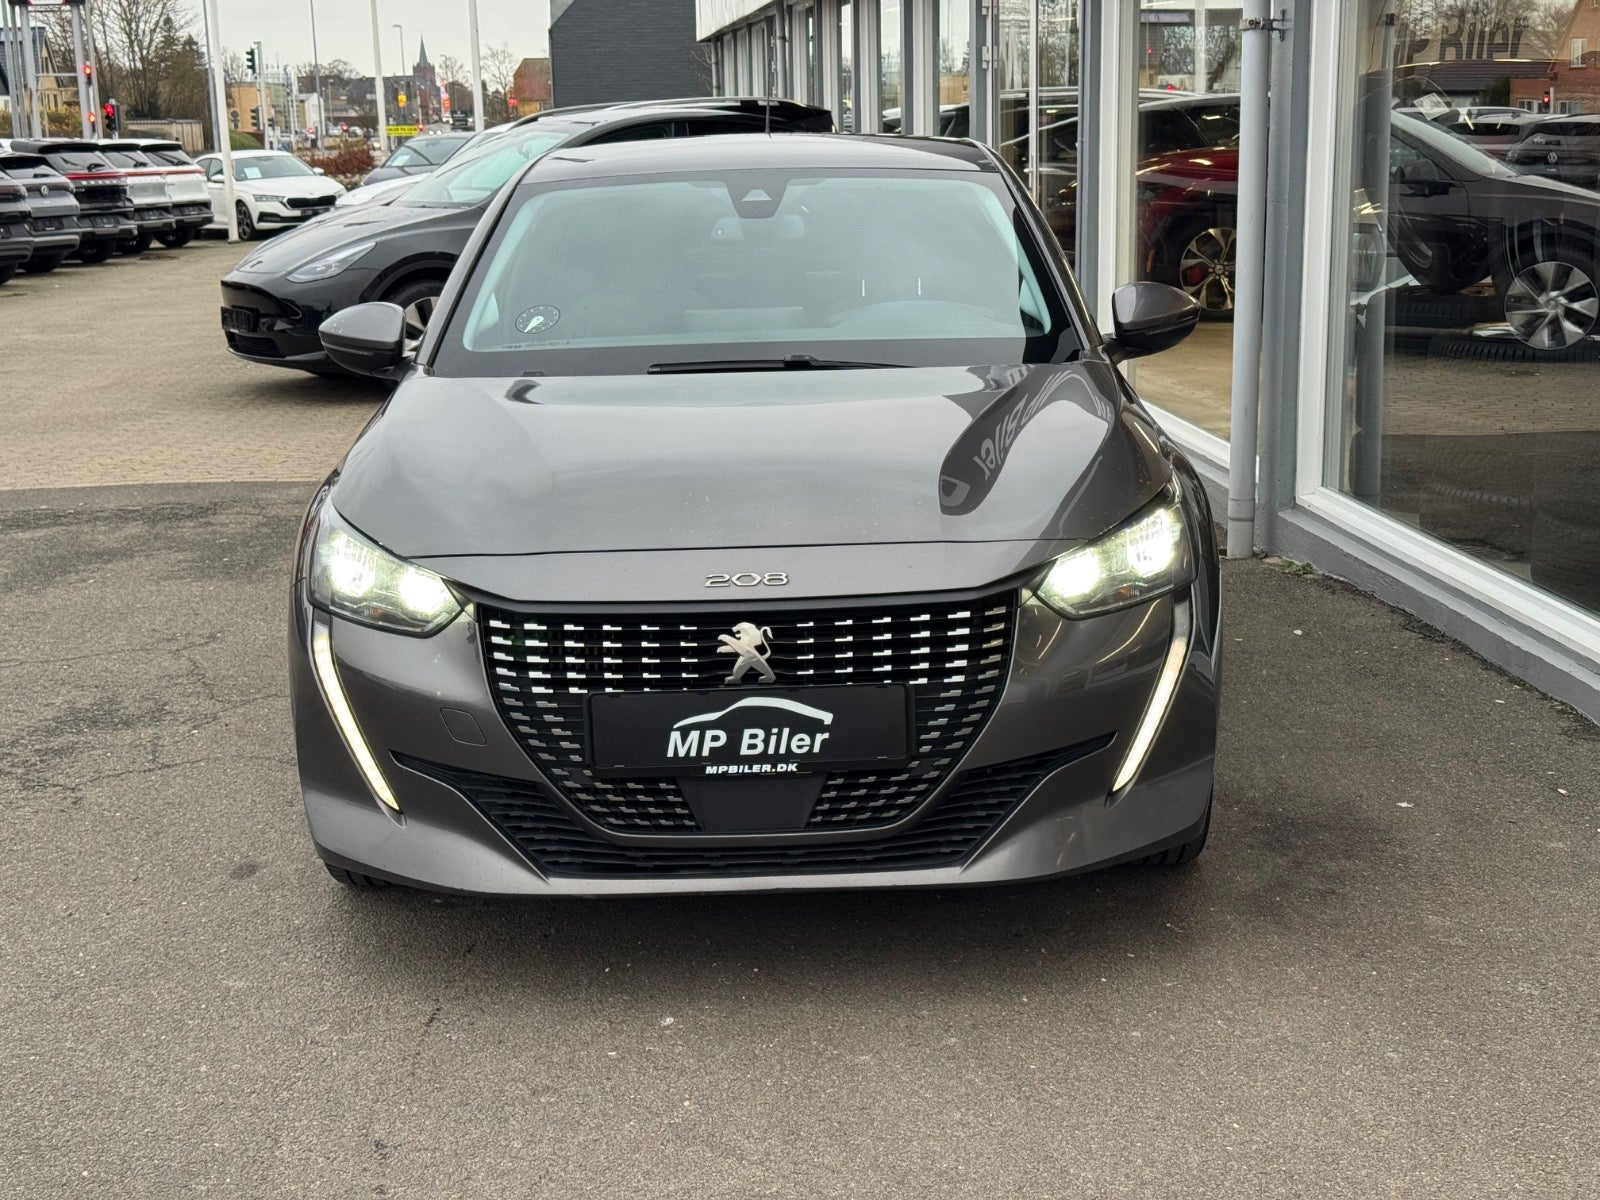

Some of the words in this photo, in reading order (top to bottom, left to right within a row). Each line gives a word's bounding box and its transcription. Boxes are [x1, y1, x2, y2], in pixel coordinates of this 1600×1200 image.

[704, 572, 790, 587] 208
[666, 730, 728, 758] MP
[739, 727, 830, 756] Biler
[705, 763, 799, 775] MPBILER.DK
